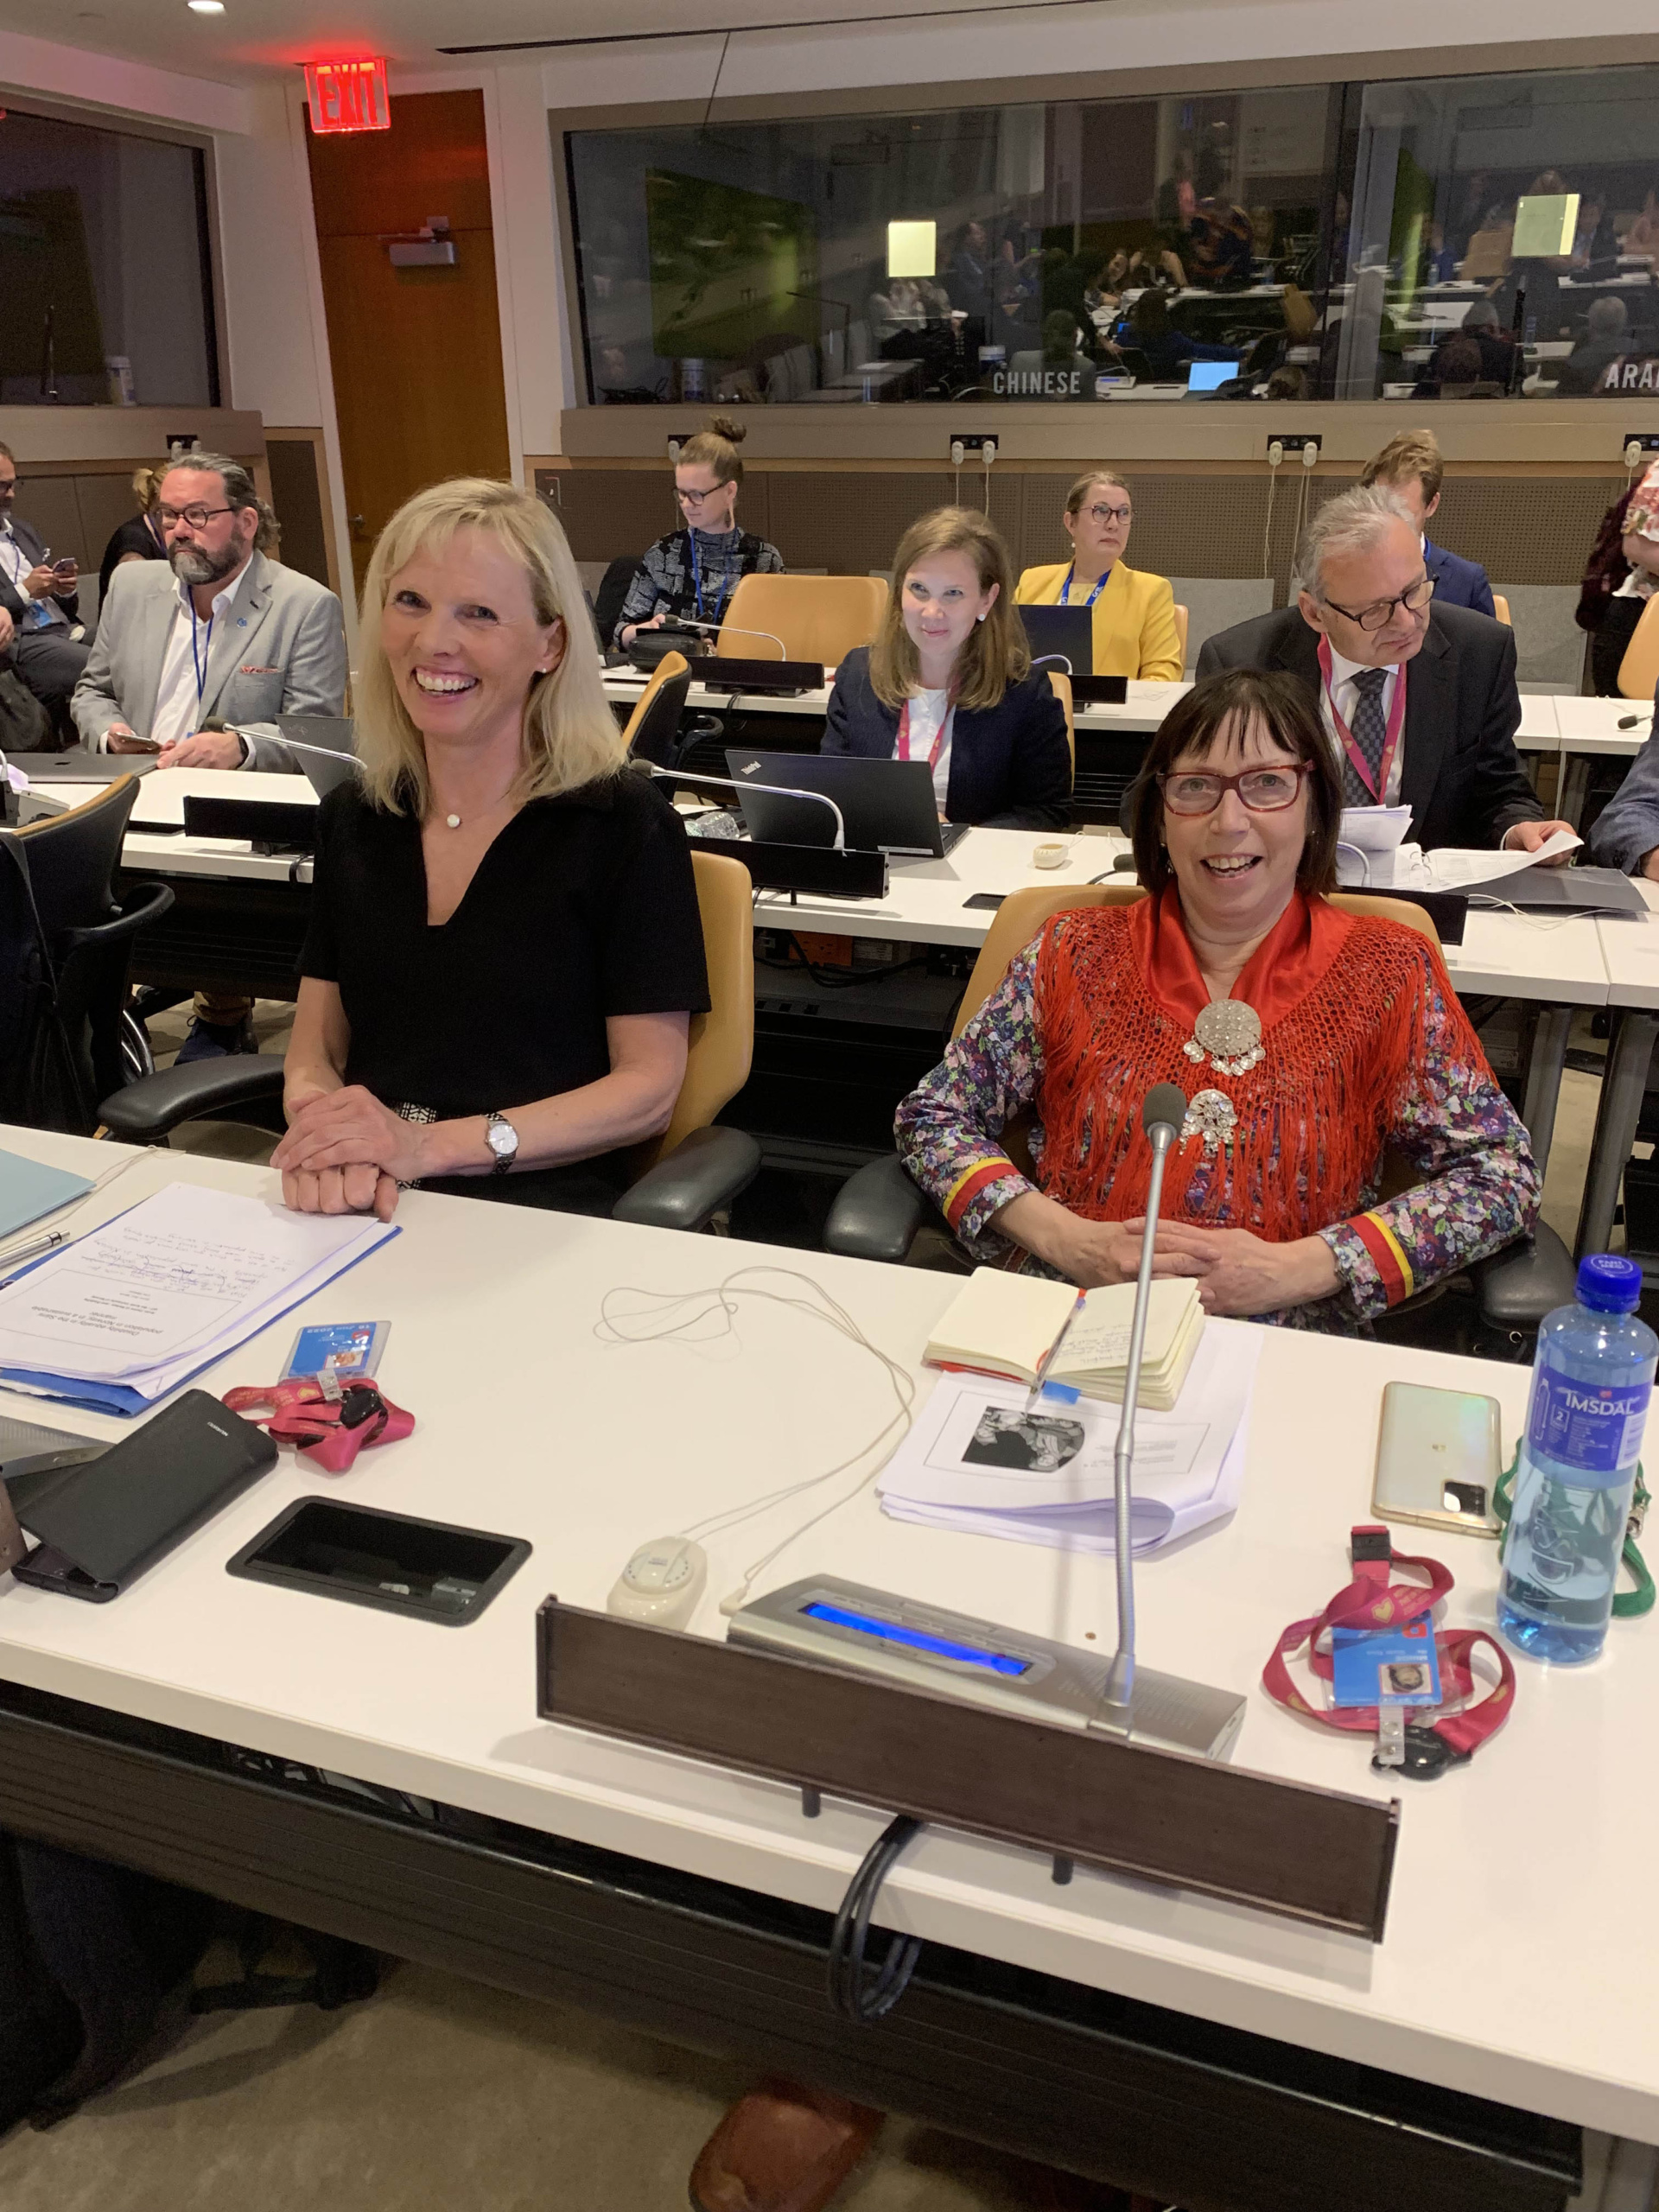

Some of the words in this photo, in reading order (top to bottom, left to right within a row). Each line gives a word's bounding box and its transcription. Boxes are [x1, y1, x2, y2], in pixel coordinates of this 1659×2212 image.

[316, 62, 378, 127] EXIT
[993, 371, 1081, 394] CHINESE
[1563, 1389, 1636, 1416] IMSDAL
